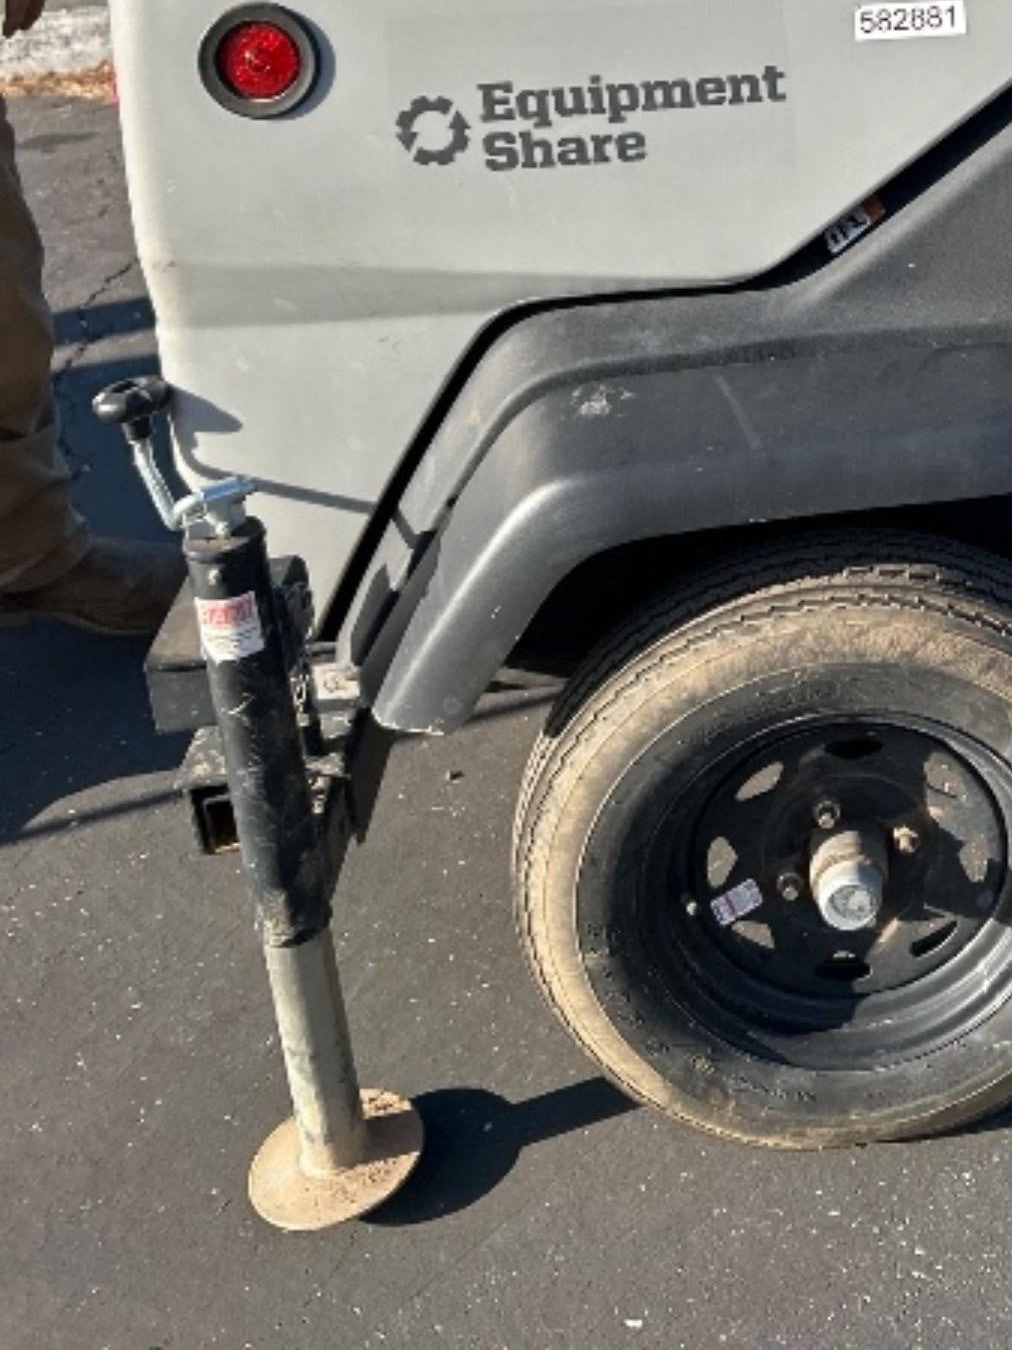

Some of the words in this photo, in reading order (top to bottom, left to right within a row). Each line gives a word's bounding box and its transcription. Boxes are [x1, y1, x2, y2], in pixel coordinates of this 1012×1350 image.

[860, 5, 955, 34] 582881
[477, 65, 787, 127] Equipment
[481, 131, 648, 172] Share
